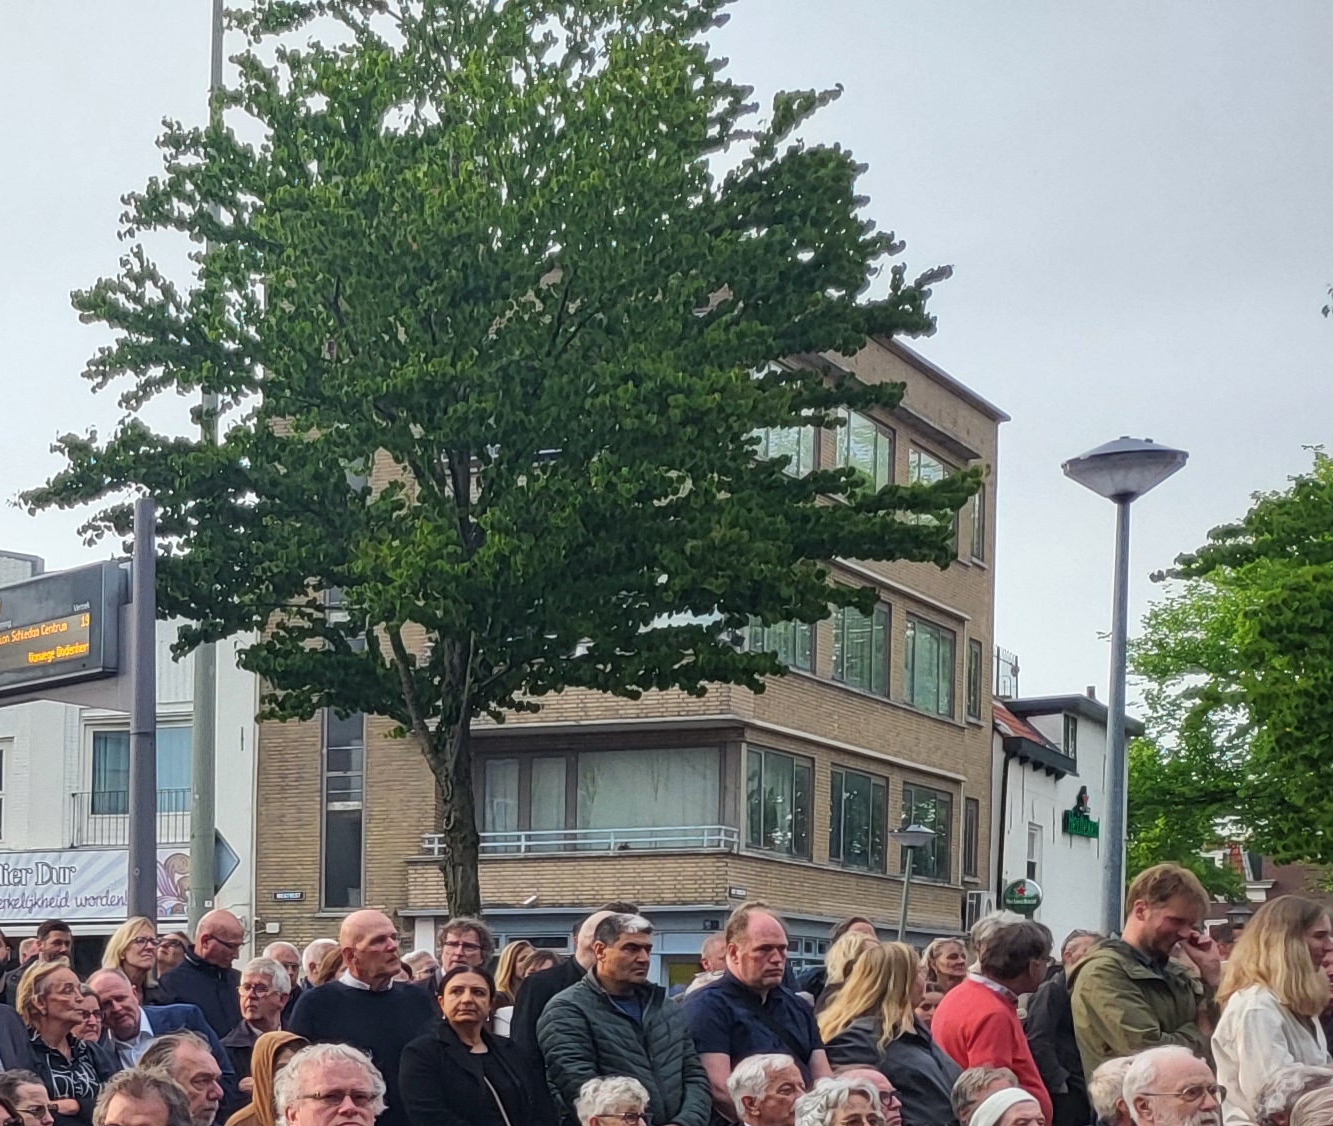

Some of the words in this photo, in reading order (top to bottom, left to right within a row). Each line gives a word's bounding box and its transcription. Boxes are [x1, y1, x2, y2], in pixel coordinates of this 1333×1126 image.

[40, 621, 68, 636] Centrum
[35, 862, 76, 886] Dur
[76, 889, 128, 908] worden!
